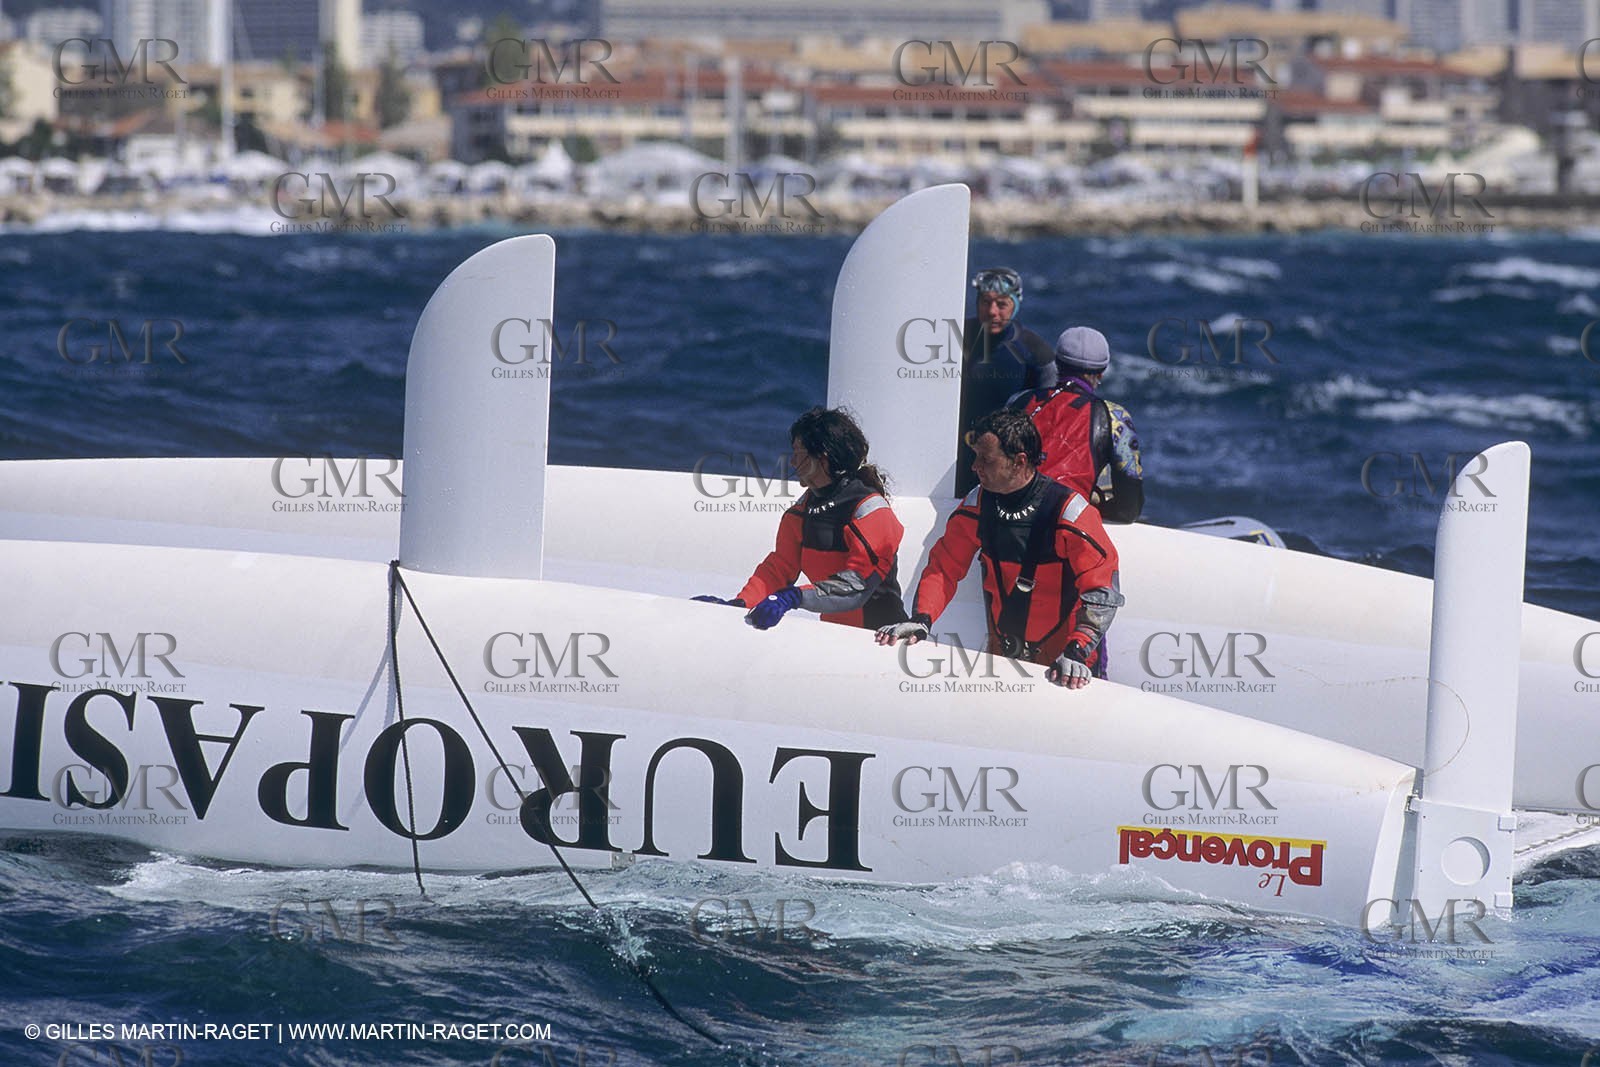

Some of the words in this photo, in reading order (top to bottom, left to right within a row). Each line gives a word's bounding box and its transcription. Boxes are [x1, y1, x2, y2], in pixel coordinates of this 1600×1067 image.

[0, 677, 877, 872] EUROPASI
[1119, 828, 1325, 886] Provençal
[1258, 872, 1288, 897] Le
